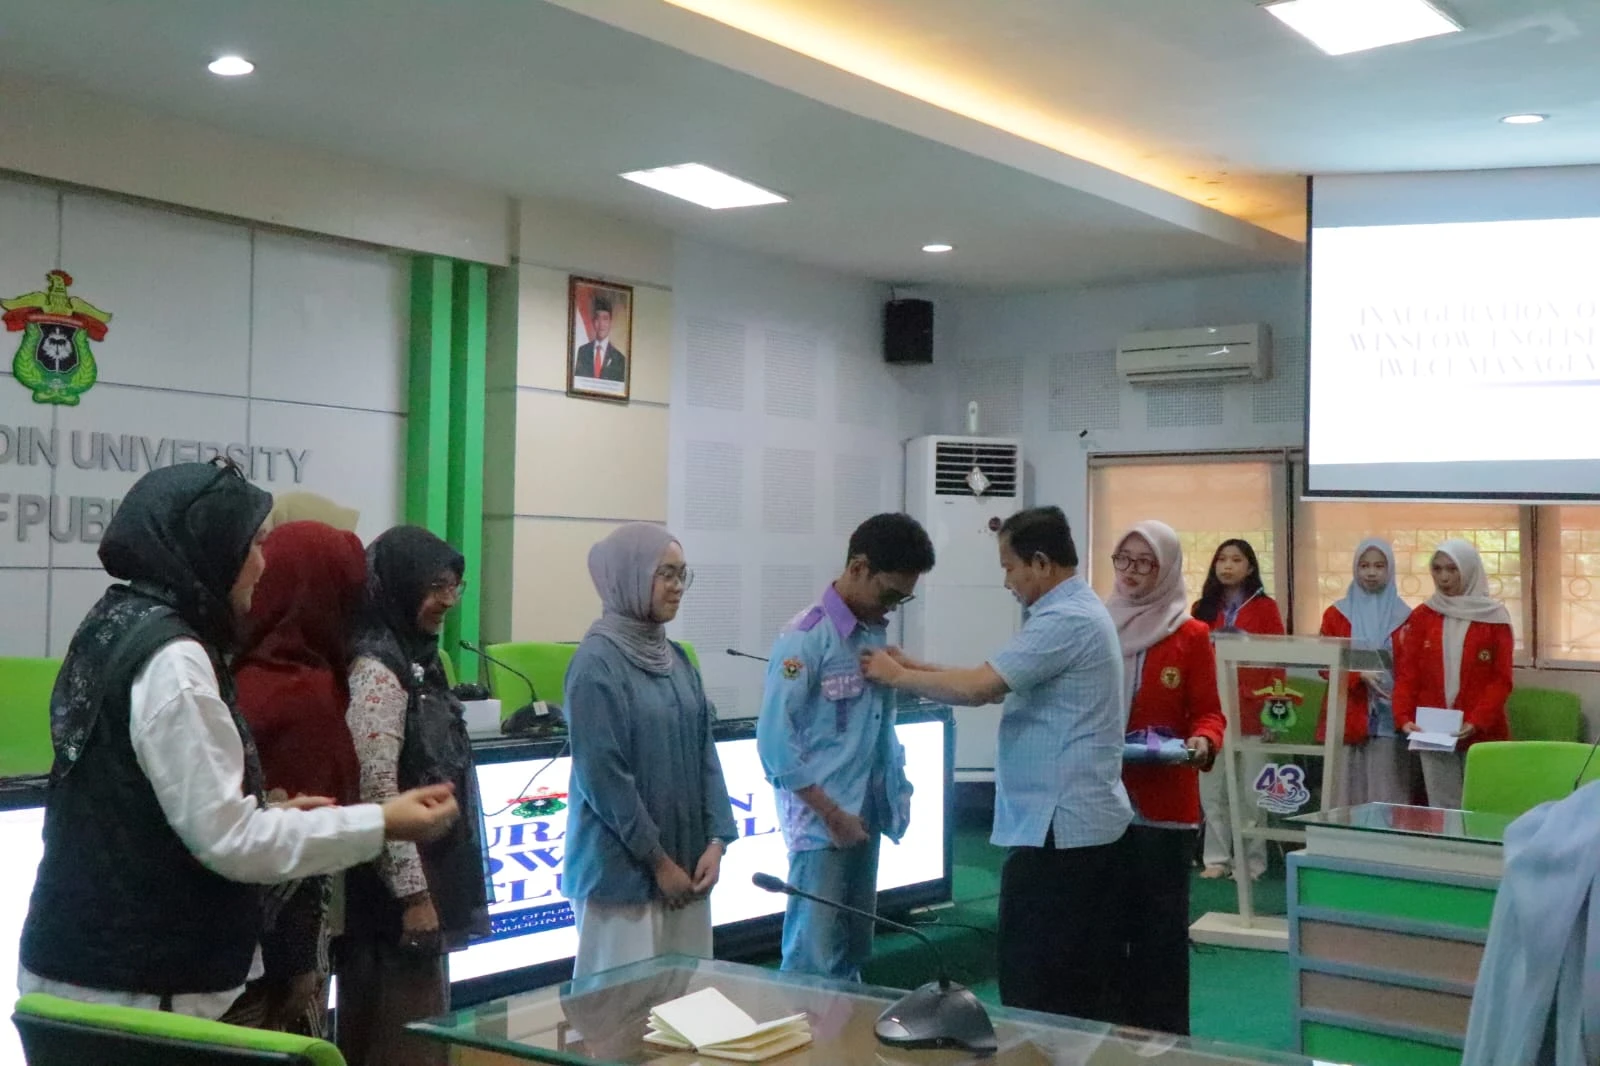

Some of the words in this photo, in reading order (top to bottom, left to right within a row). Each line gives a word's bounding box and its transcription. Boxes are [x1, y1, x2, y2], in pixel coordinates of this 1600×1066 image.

[1349, 330, 1470, 353] WINSLOW
[71, 430, 313, 483] UNIVERSITY
[1255, 766, 1303, 793] 43
